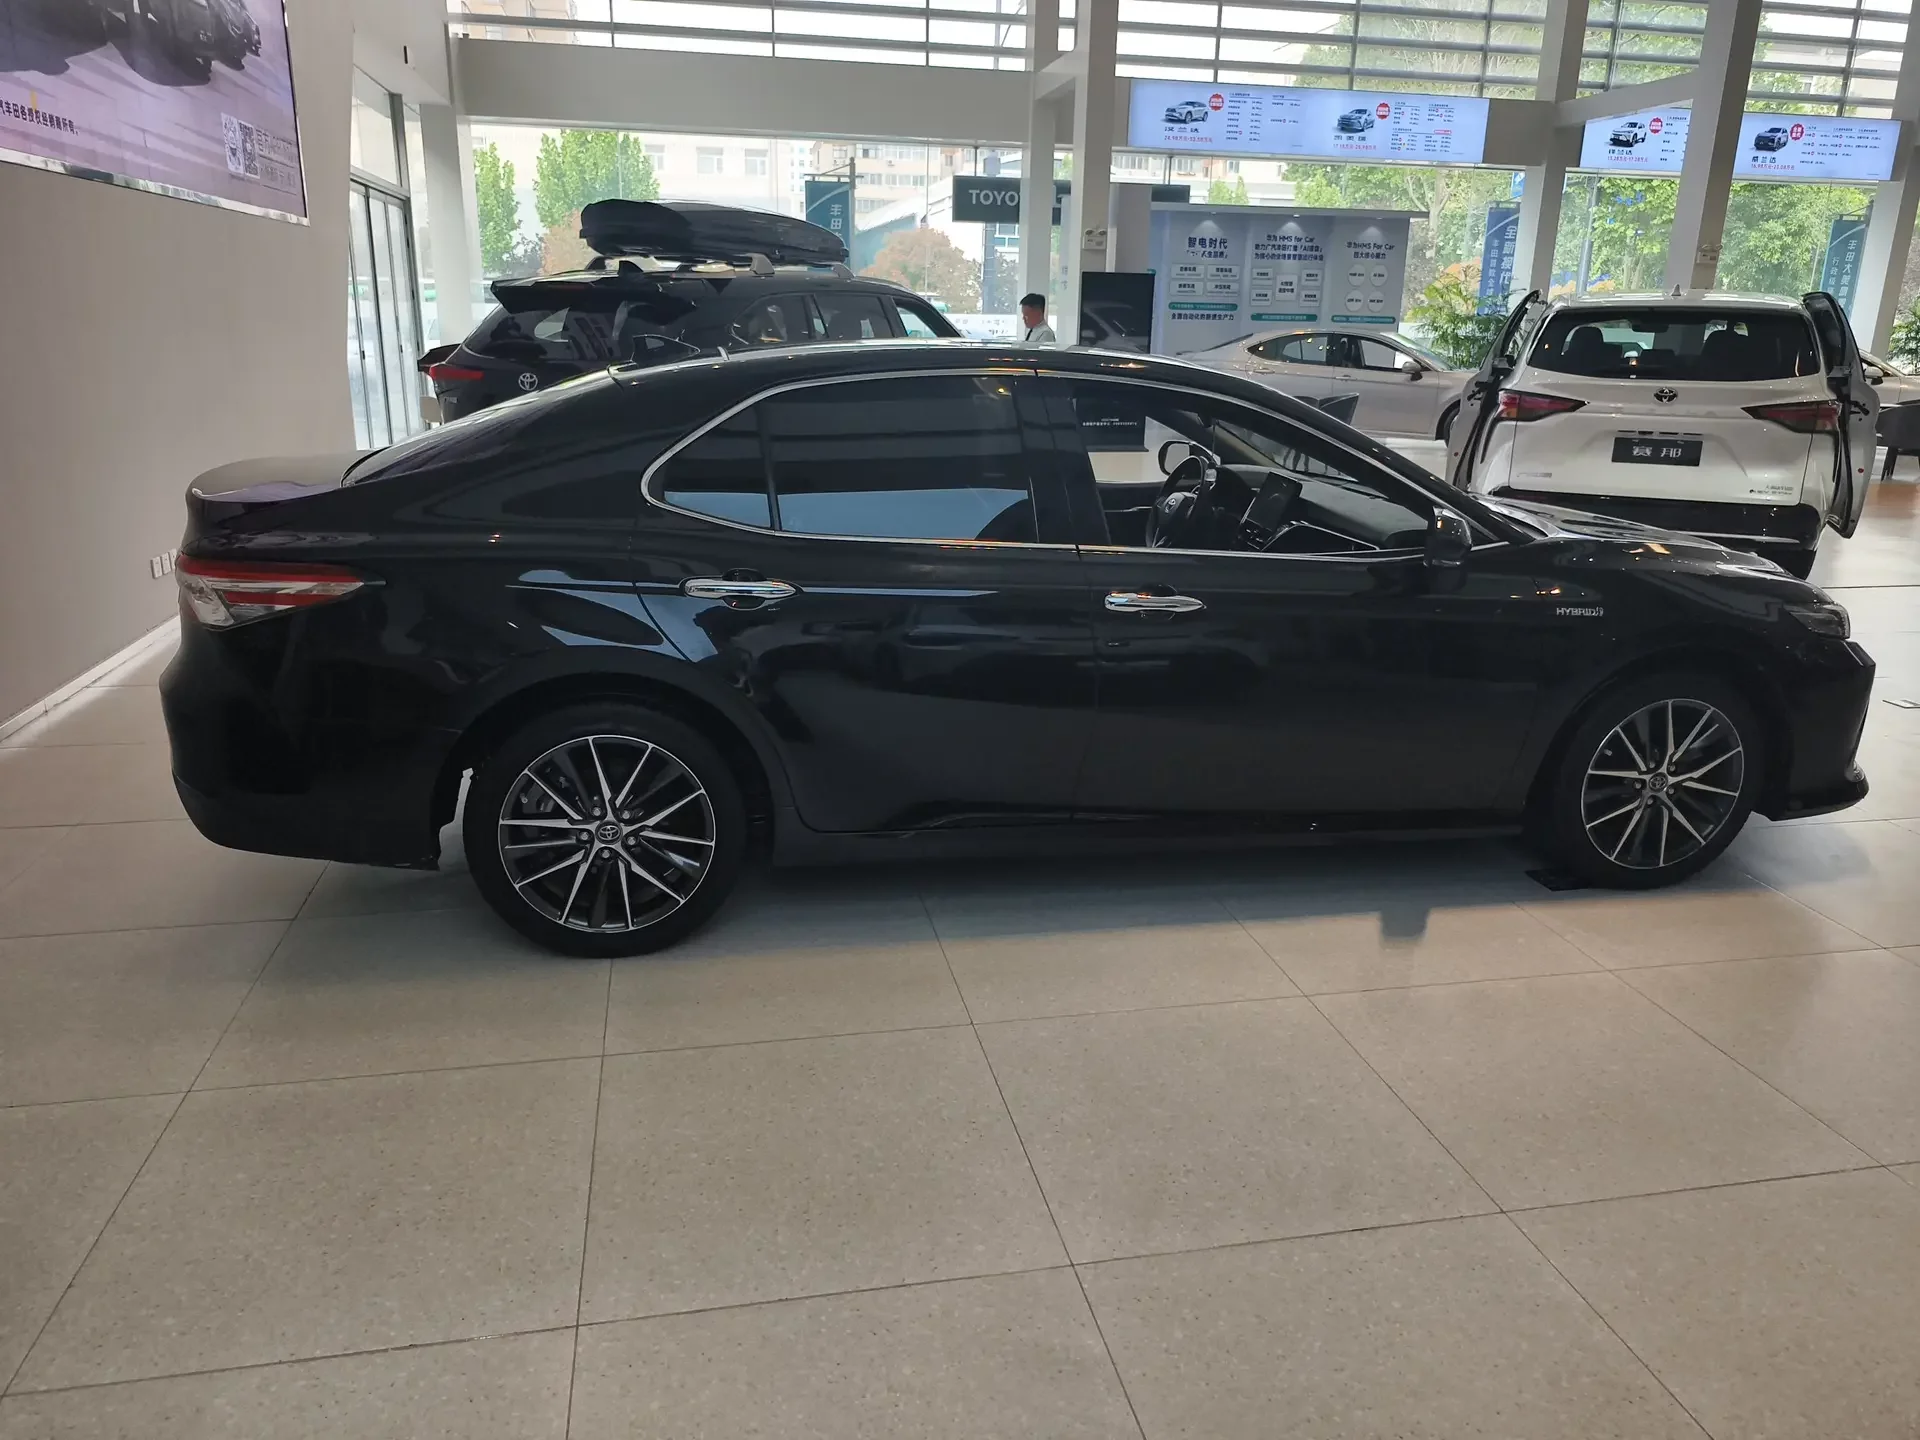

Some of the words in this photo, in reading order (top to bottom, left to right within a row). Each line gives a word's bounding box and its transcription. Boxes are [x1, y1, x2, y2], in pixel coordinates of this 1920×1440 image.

[968, 189, 1020, 206] TOYO
[1188, 236, 1228, 249] 智电时代
